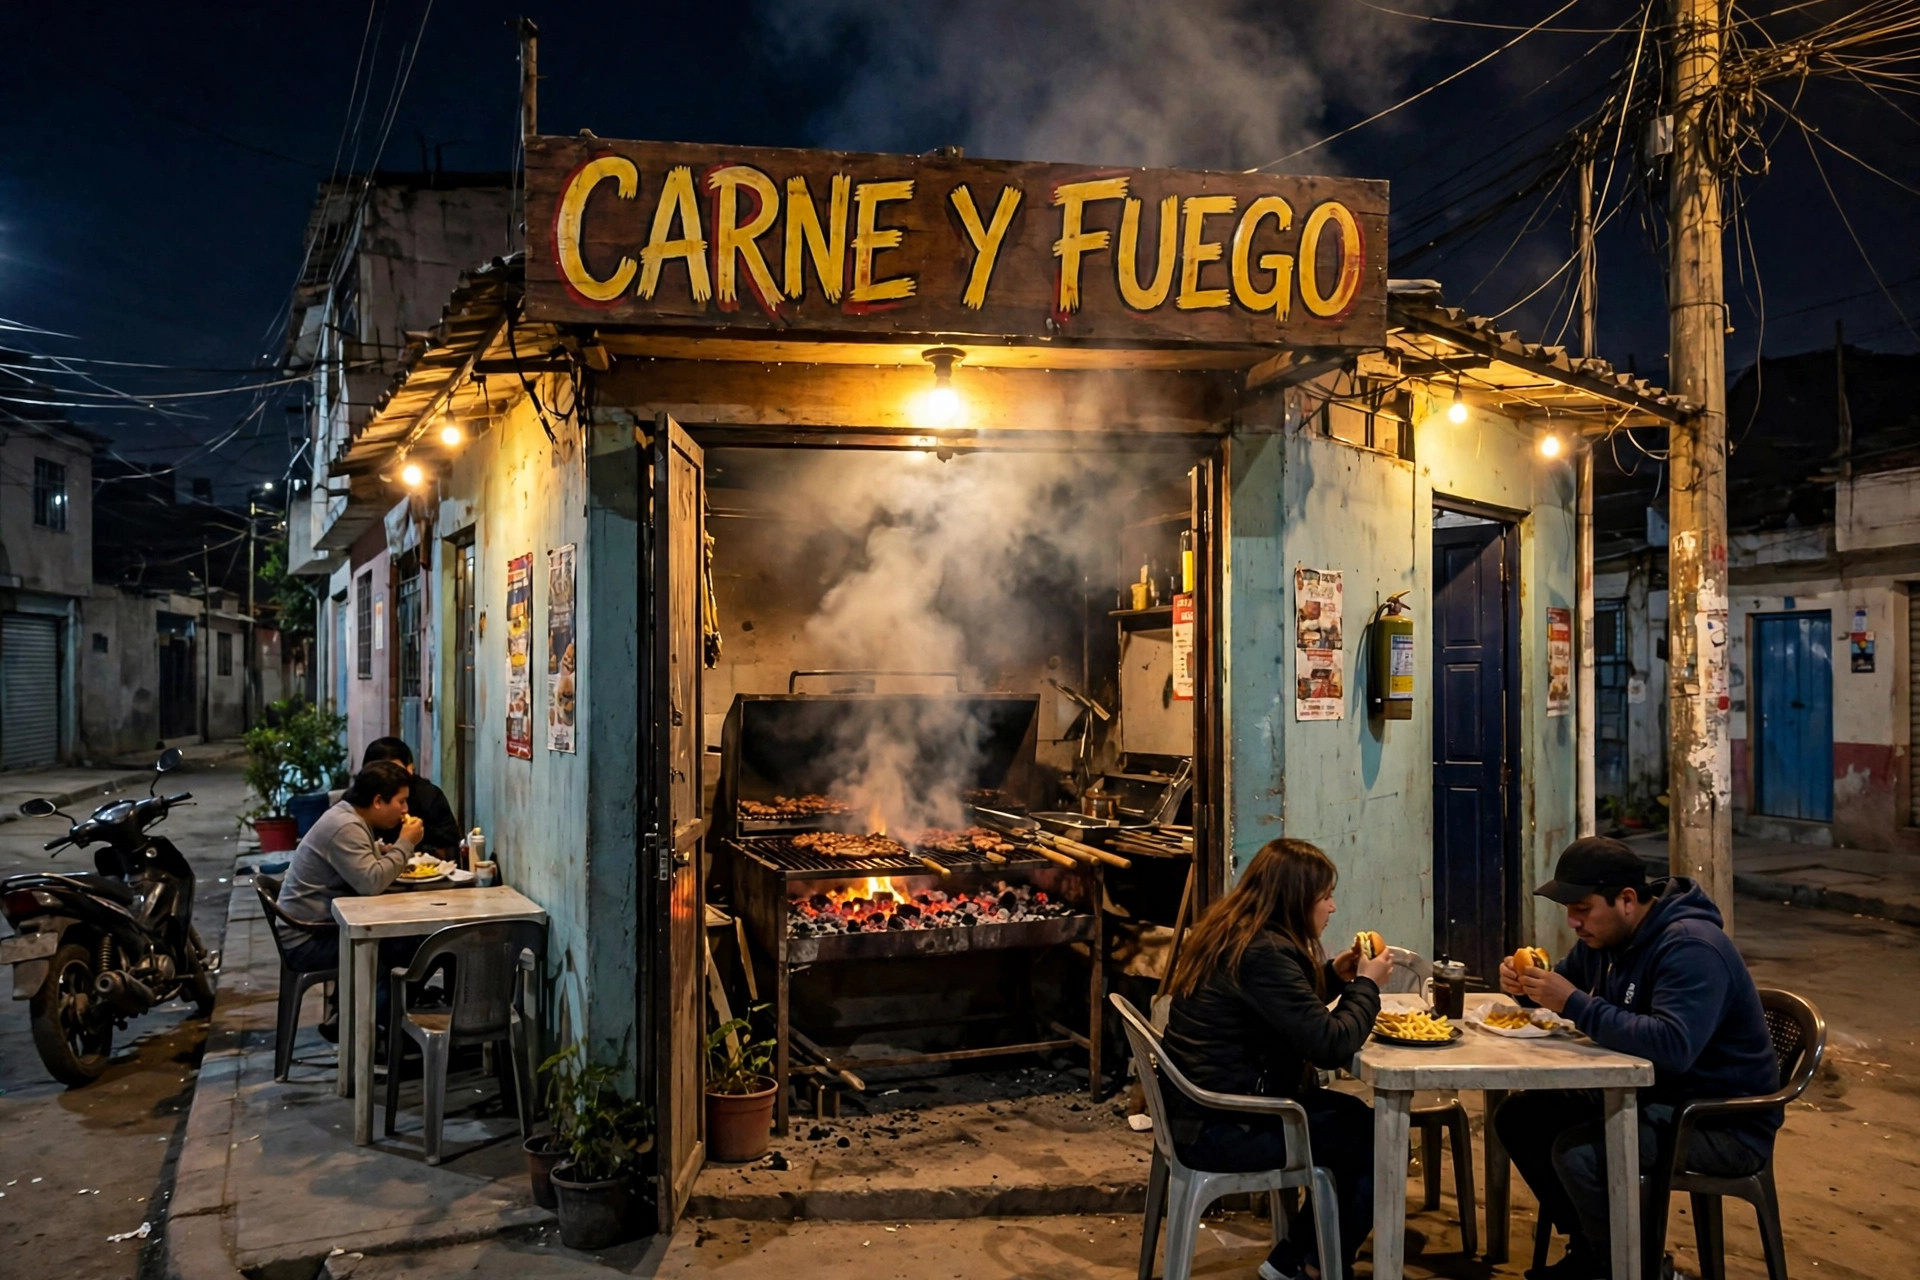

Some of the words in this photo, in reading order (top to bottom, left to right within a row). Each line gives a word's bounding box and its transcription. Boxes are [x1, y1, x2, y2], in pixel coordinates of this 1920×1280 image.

[555, 155, 916, 311] CARNE
[950, 184, 1022, 310] Y
[1053, 175, 1363, 322] FUEGO
